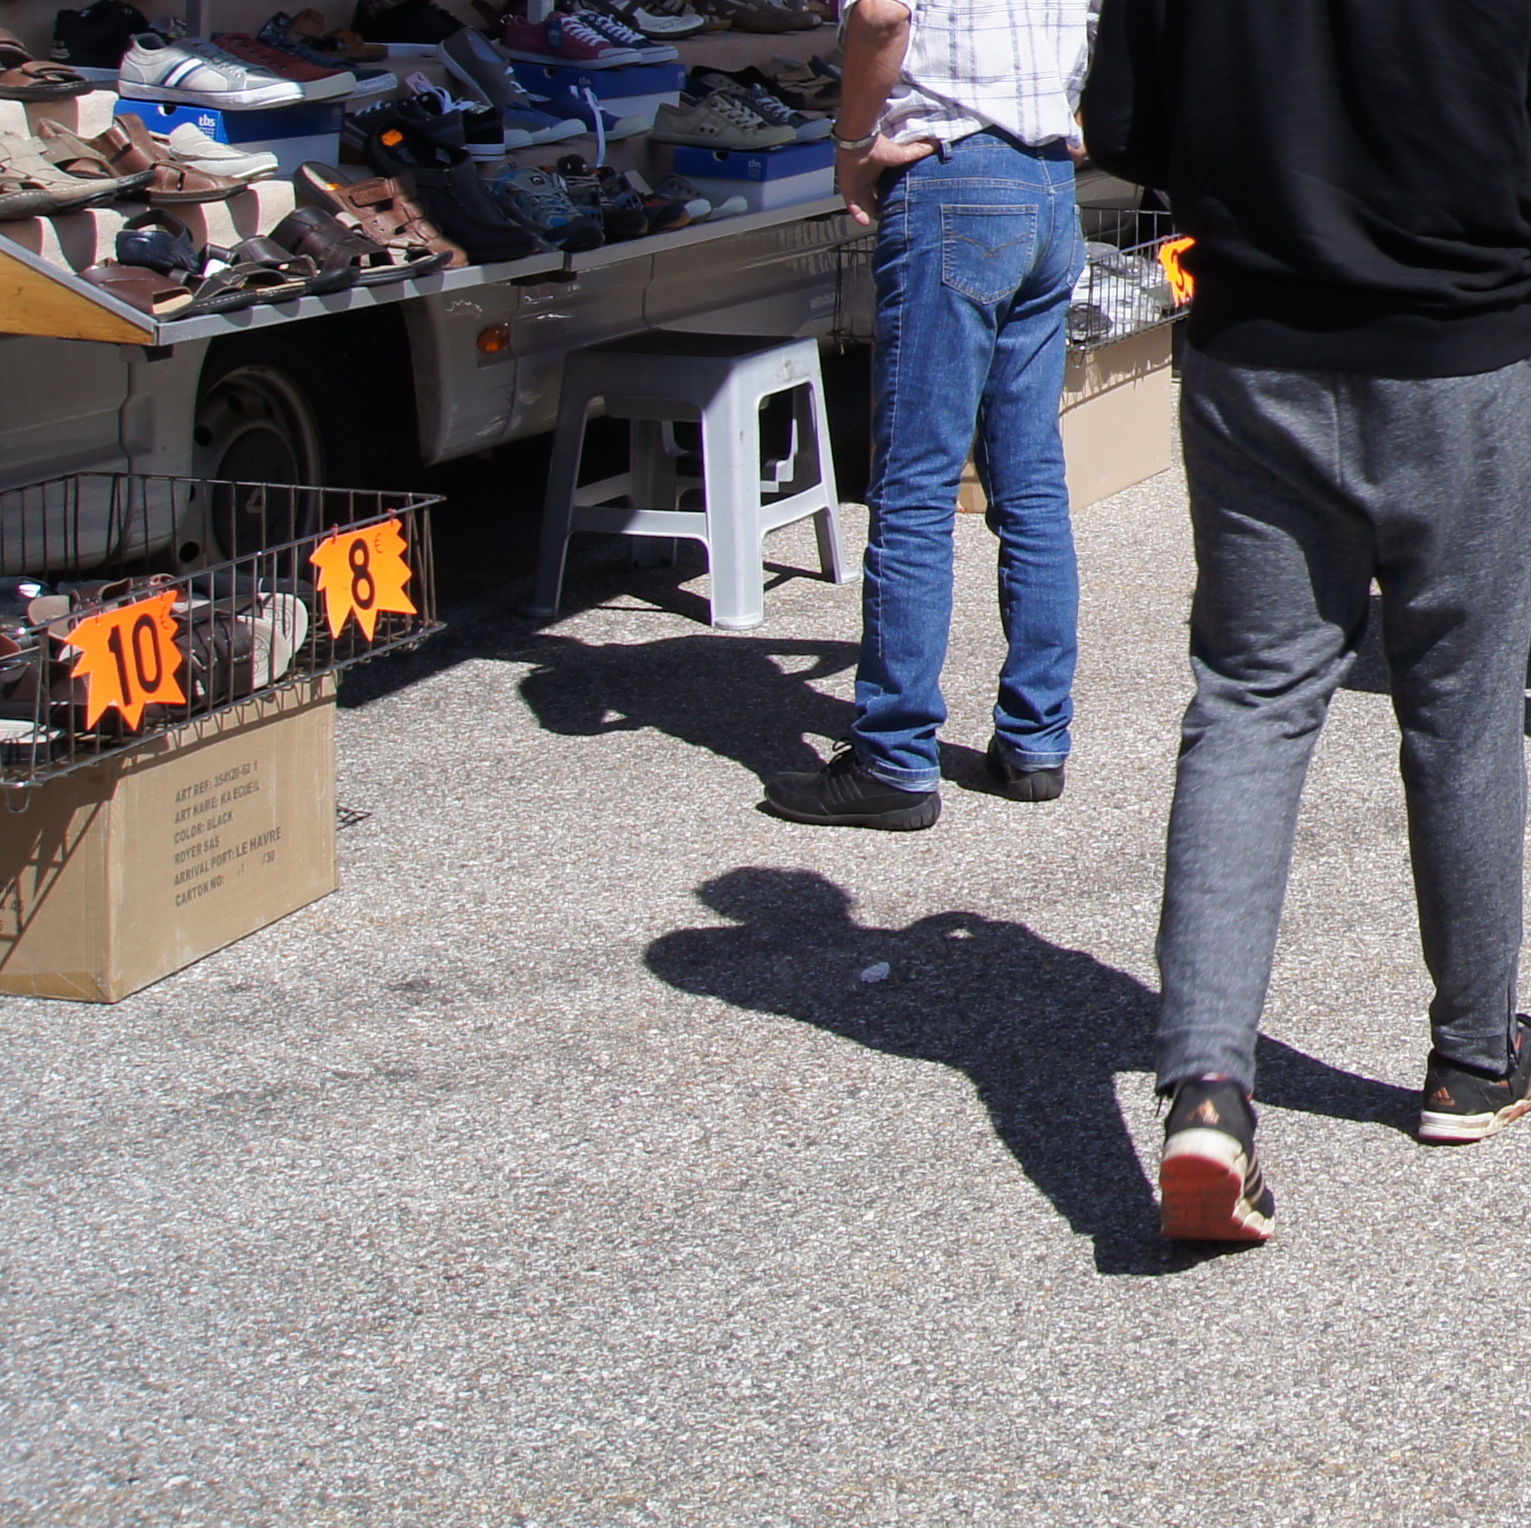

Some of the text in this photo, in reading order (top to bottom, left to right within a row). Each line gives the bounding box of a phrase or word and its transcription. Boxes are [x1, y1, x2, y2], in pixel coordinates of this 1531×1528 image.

[197, 113, 217, 129] tbs
[175, 786, 193, 804] ART
[175, 805, 192, 825] ART
[174, 810, 234, 845] COLOR: BLACK
[174, 845, 203, 866] ROYER
[174, 863, 210, 887] ARRIVAL
[249, 826, 282, 853] HAVRE
[175, 880, 209, 908] CARTON
